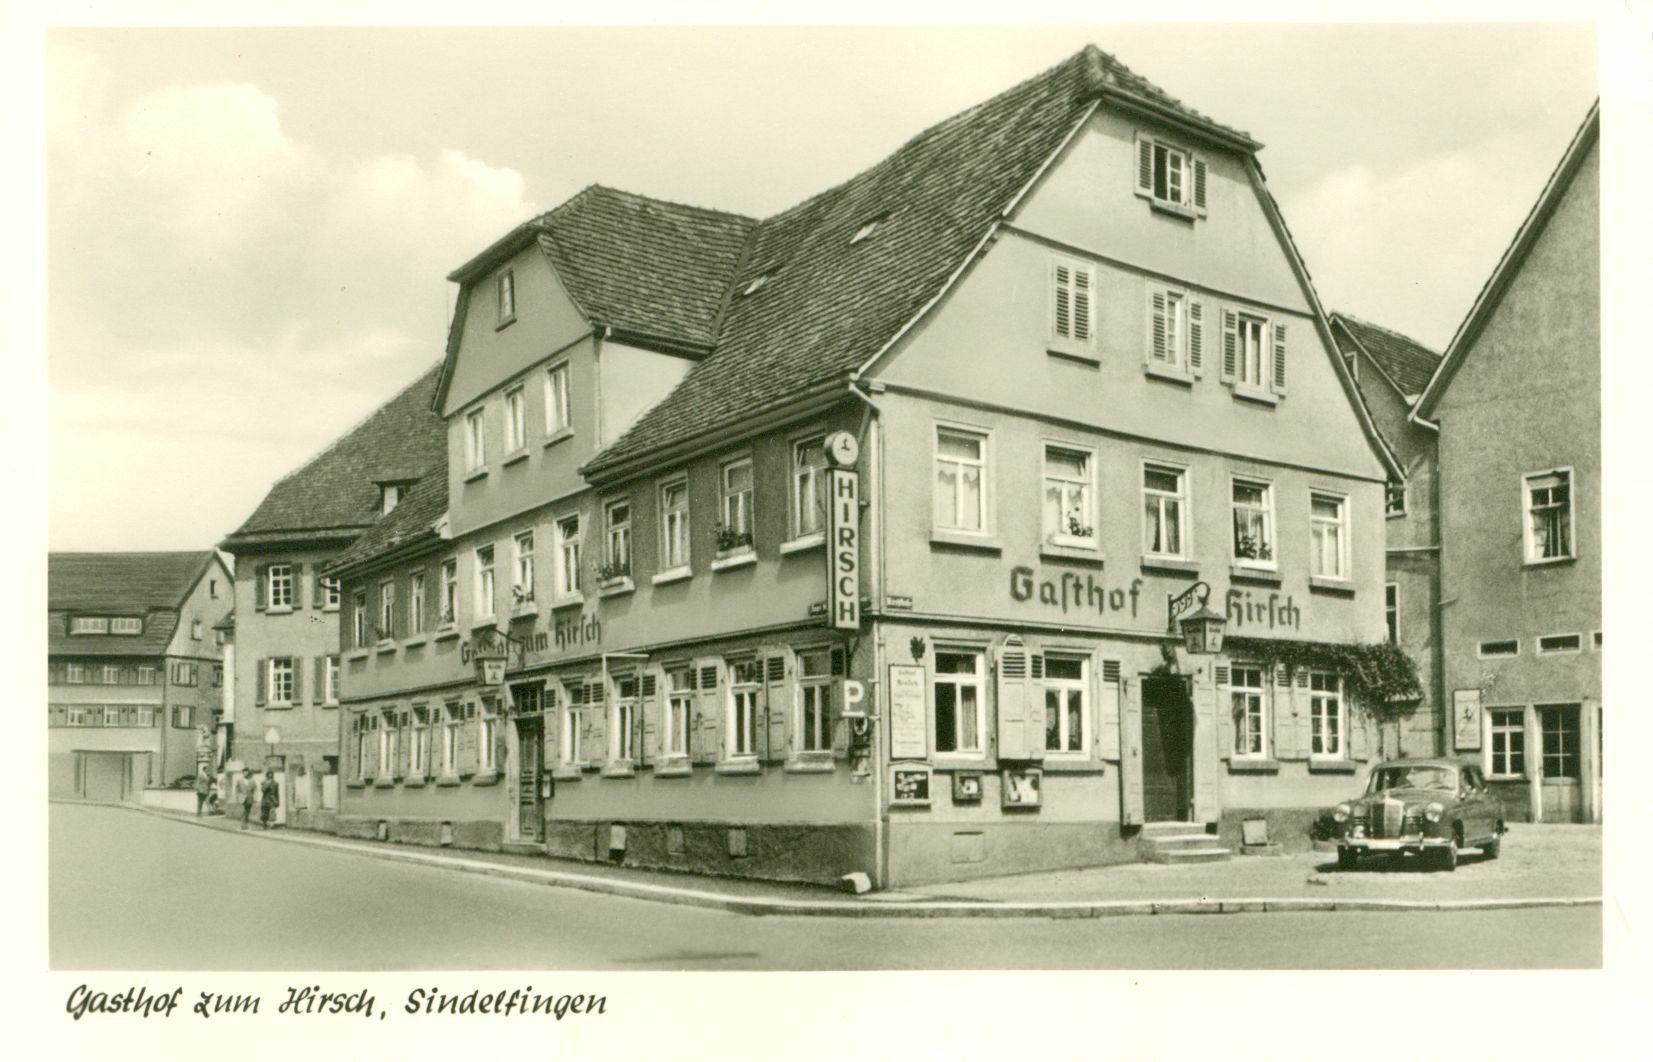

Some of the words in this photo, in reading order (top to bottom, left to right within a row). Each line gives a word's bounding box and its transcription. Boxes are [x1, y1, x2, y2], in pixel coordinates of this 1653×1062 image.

[837, 477, 855, 622] HIRSCH
[1010, 565, 1143, 618] Gasthof
[1225, 588, 1301, 630] Hirsch
[844, 680, 864, 711] P
